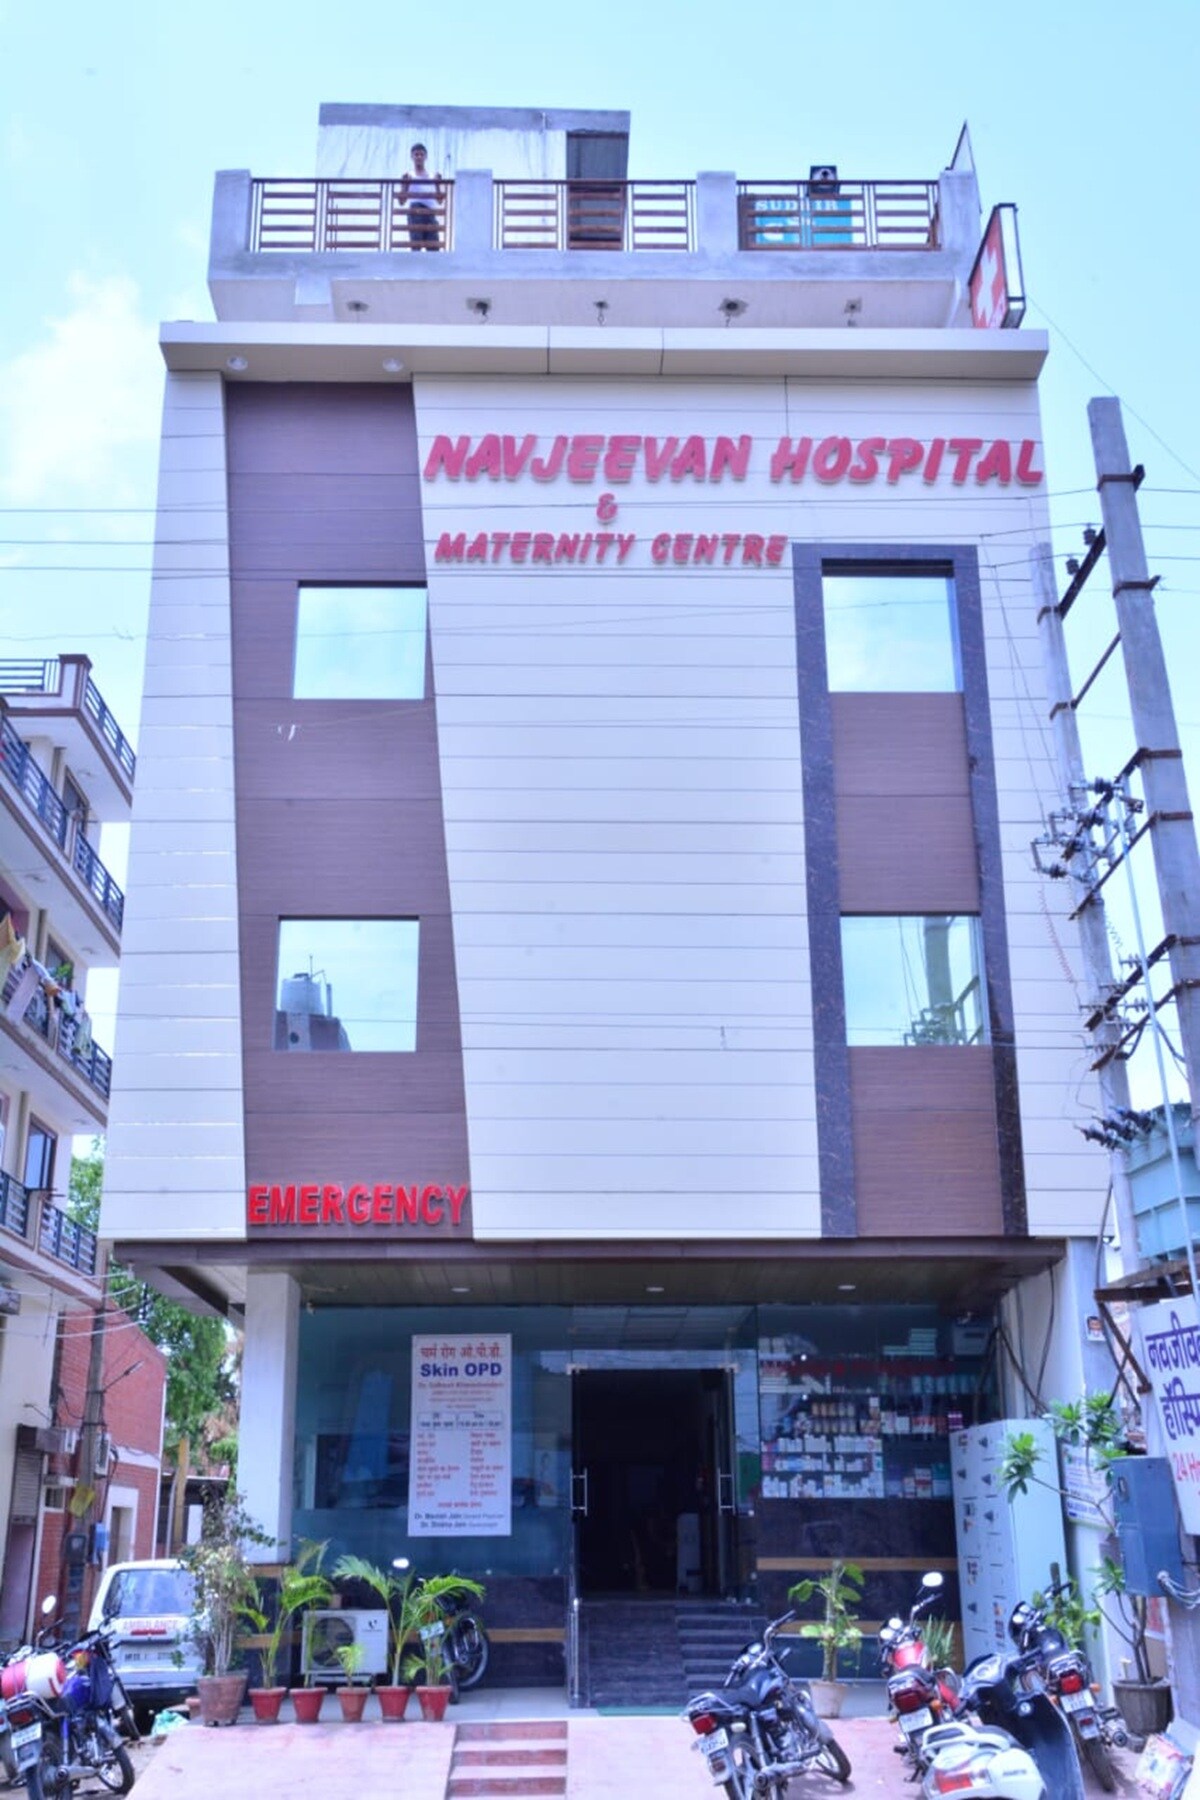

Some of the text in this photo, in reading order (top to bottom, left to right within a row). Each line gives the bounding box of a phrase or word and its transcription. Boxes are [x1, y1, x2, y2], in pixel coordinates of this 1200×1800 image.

[423, 433, 1044, 485] NAVJEEVAN HOSPITAL
[596, 493, 618, 523] &
[434, 531, 787, 565] MATERNITY CENTRE
[247, 1183, 469, 1225] EMERGENCY
[420, 1362, 502, 1377] Skin OPD
